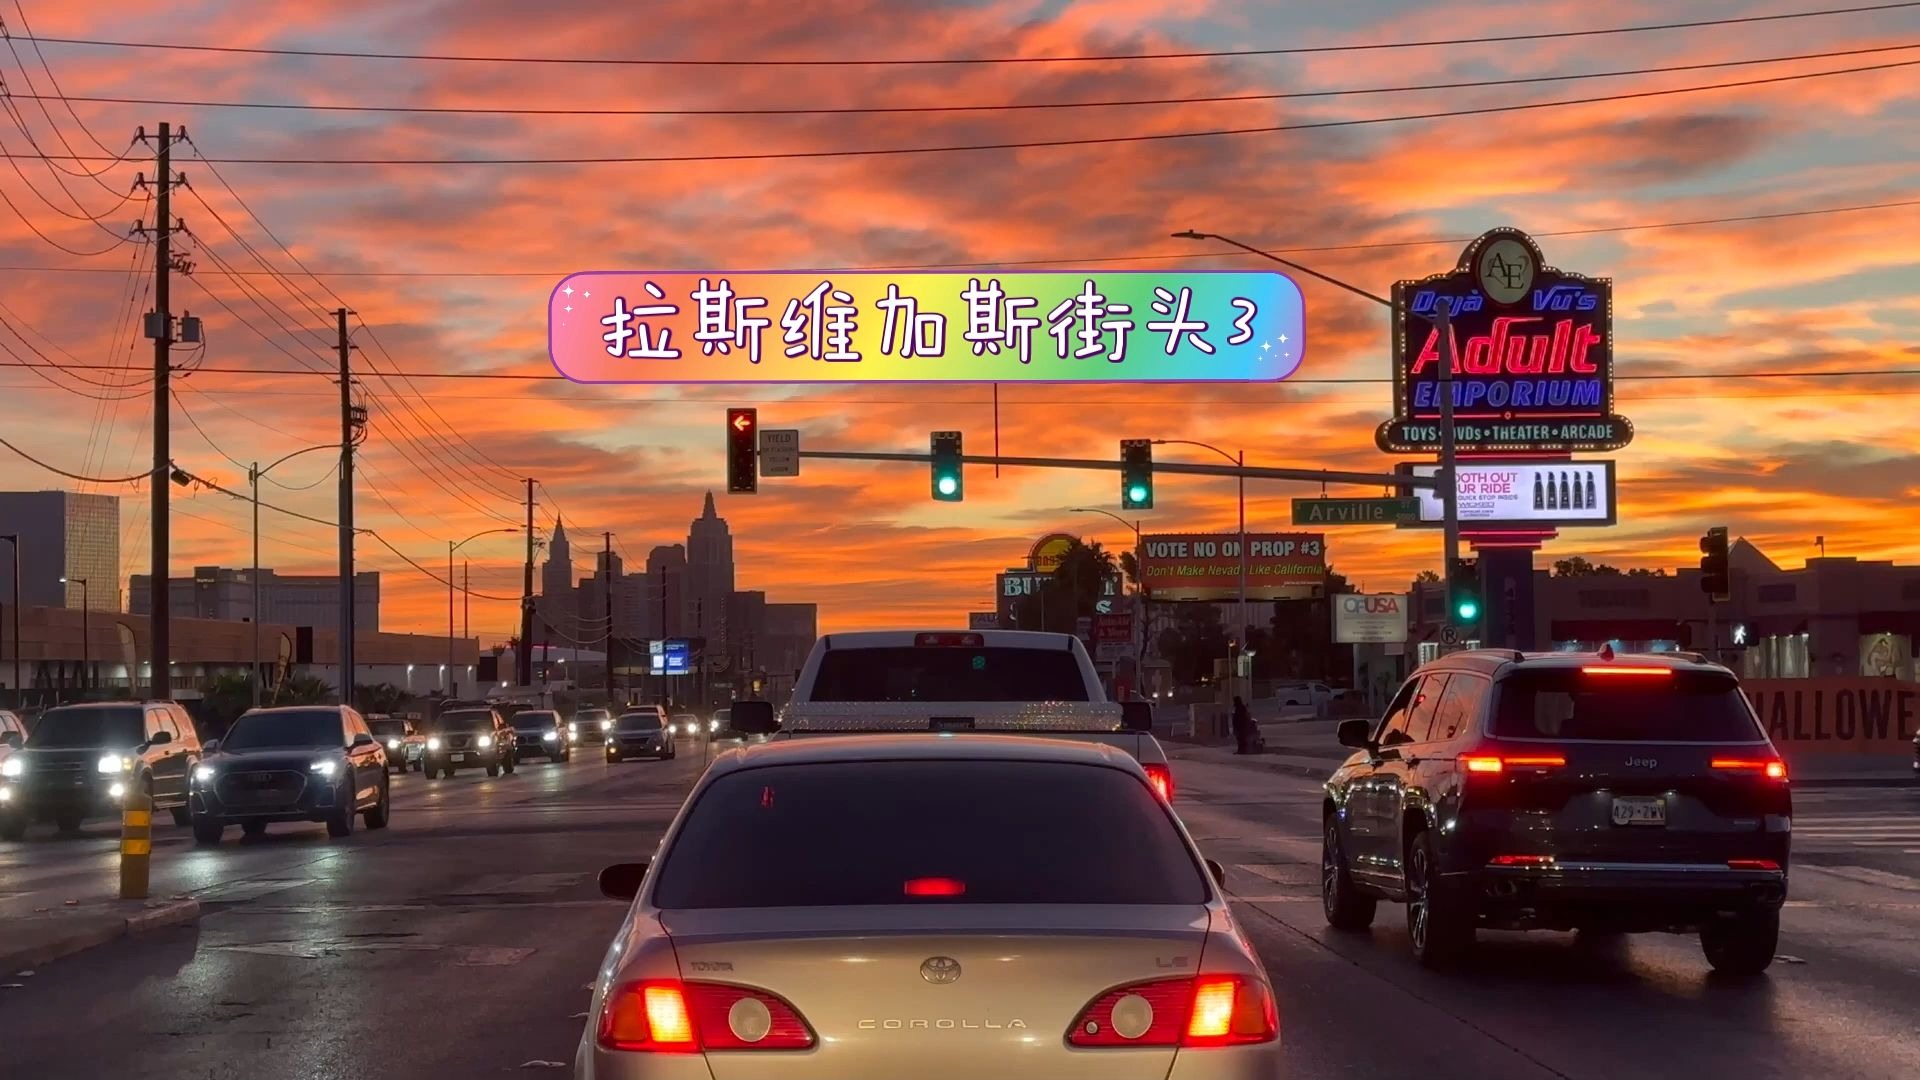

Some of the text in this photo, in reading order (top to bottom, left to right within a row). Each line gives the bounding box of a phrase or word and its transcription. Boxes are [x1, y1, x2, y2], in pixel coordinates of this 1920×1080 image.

[1411, 316, 1601, 374] Adult
[1414, 380, 1601, 407] EMPORIUM
[1402, 424, 1613, 441] TOYS VDs THEATER ARCADE
[1456, 472, 1518, 483] OTH OUT
[1481, 483, 1511, 493] RIDE
[1309, 503, 1384, 520] Arville
[1147, 542, 1188, 558] VOTE
[1193, 541, 1217, 557] NO
[1251, 541, 1295, 557] PROP
[1300, 541, 1320, 556] #3
[1176, 565, 1205, 577] Make
[1208, 565, 1246, 576] Nevad
[1249, 564, 1271, 576] Like
[1273, 563, 1323, 575] California
[1624, 756, 1657, 769] Jeep
[857, 1019, 1028, 1030] COROLLA
